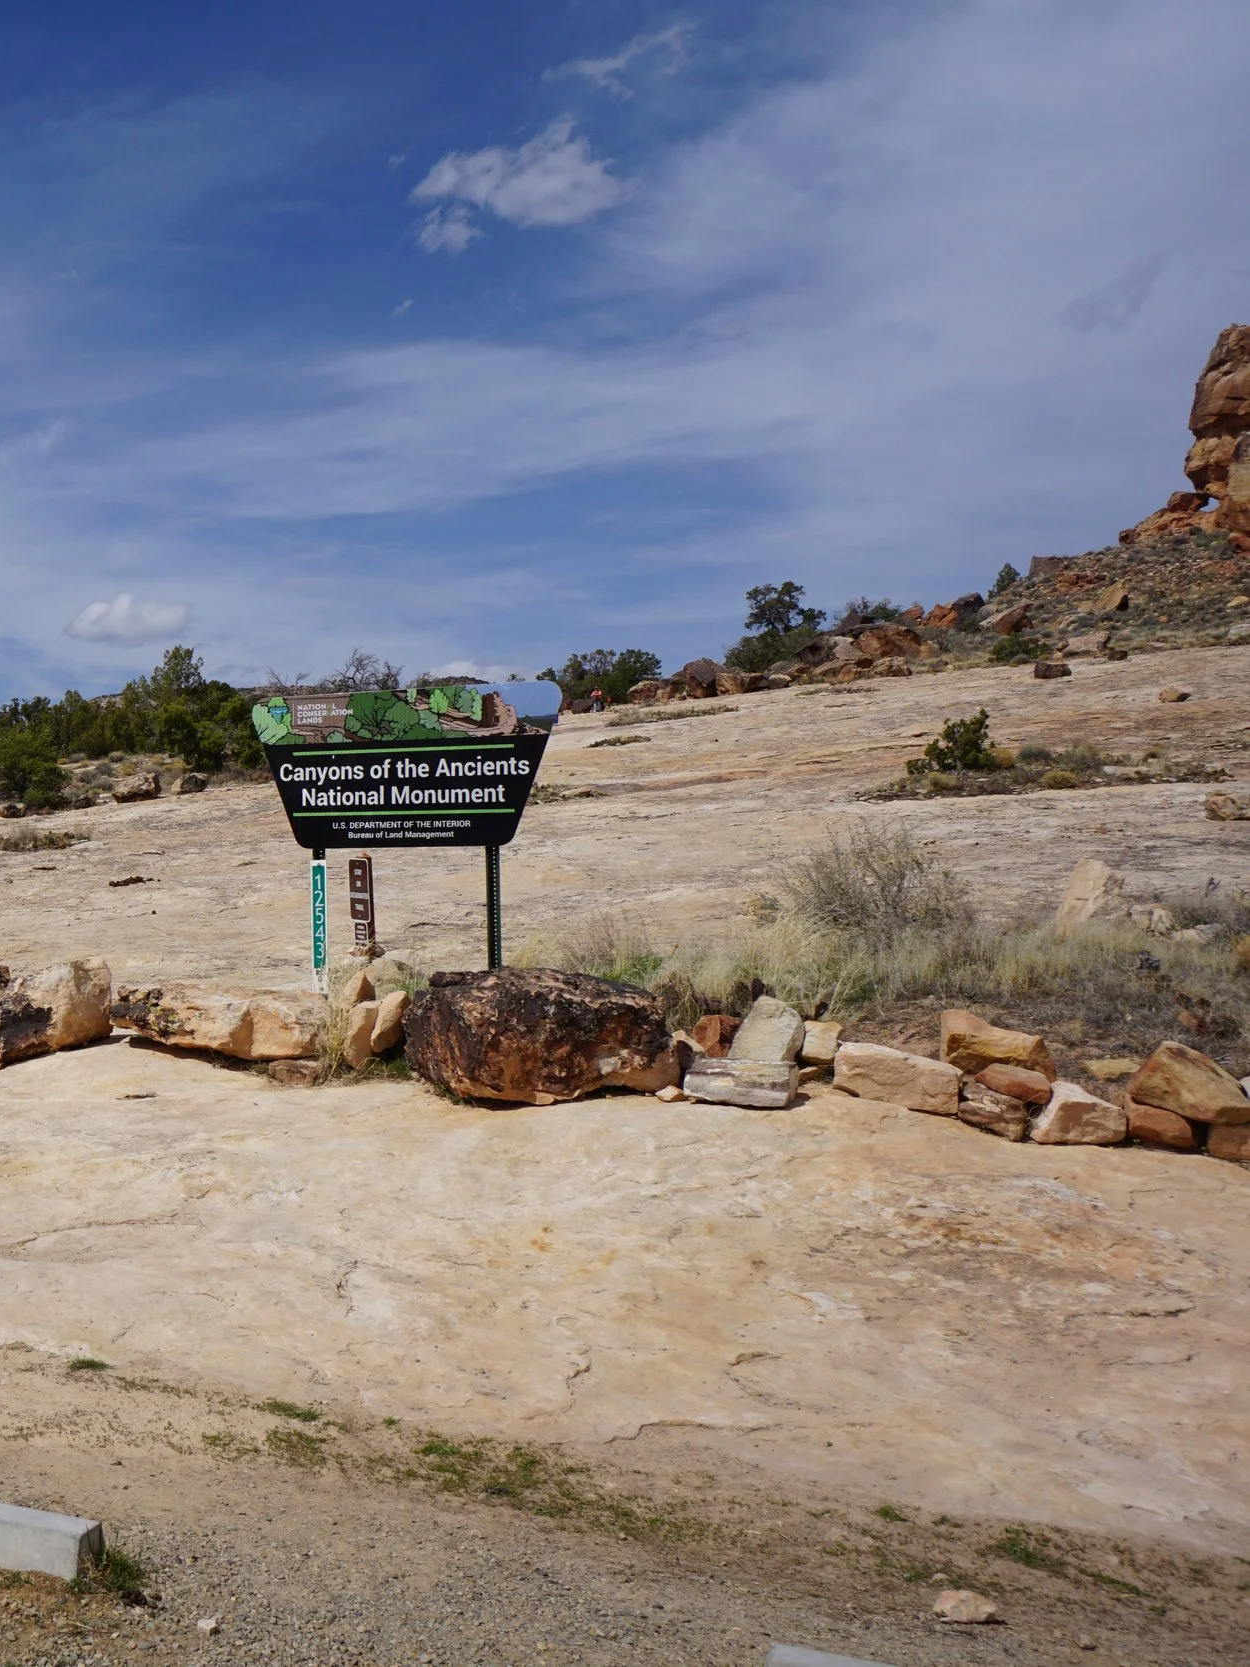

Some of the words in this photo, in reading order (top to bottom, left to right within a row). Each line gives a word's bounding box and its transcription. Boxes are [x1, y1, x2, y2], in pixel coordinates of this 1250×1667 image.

[280, 763, 364, 785] Canyons
[370, 759, 391, 778] of
[396, 758, 429, 778] the
[435, 756, 530, 777] Ancients
[301, 785, 385, 806] National
[391, 784, 505, 805] Monument
[332, 821, 348, 829] U.S.
[349, 821, 402, 829] DEPARTMENT
[403, 821, 414, 829] OF
[415, 820, 431, 828] THE
[433, 820, 471, 828] INTERIOR
[348, 831, 373, 839] Bureau
[375, 831, 384, 839] of
[385, 831, 403, 839] Land
[405, 830, 454, 840] Management
[314, 873, 325, 959] 12543
